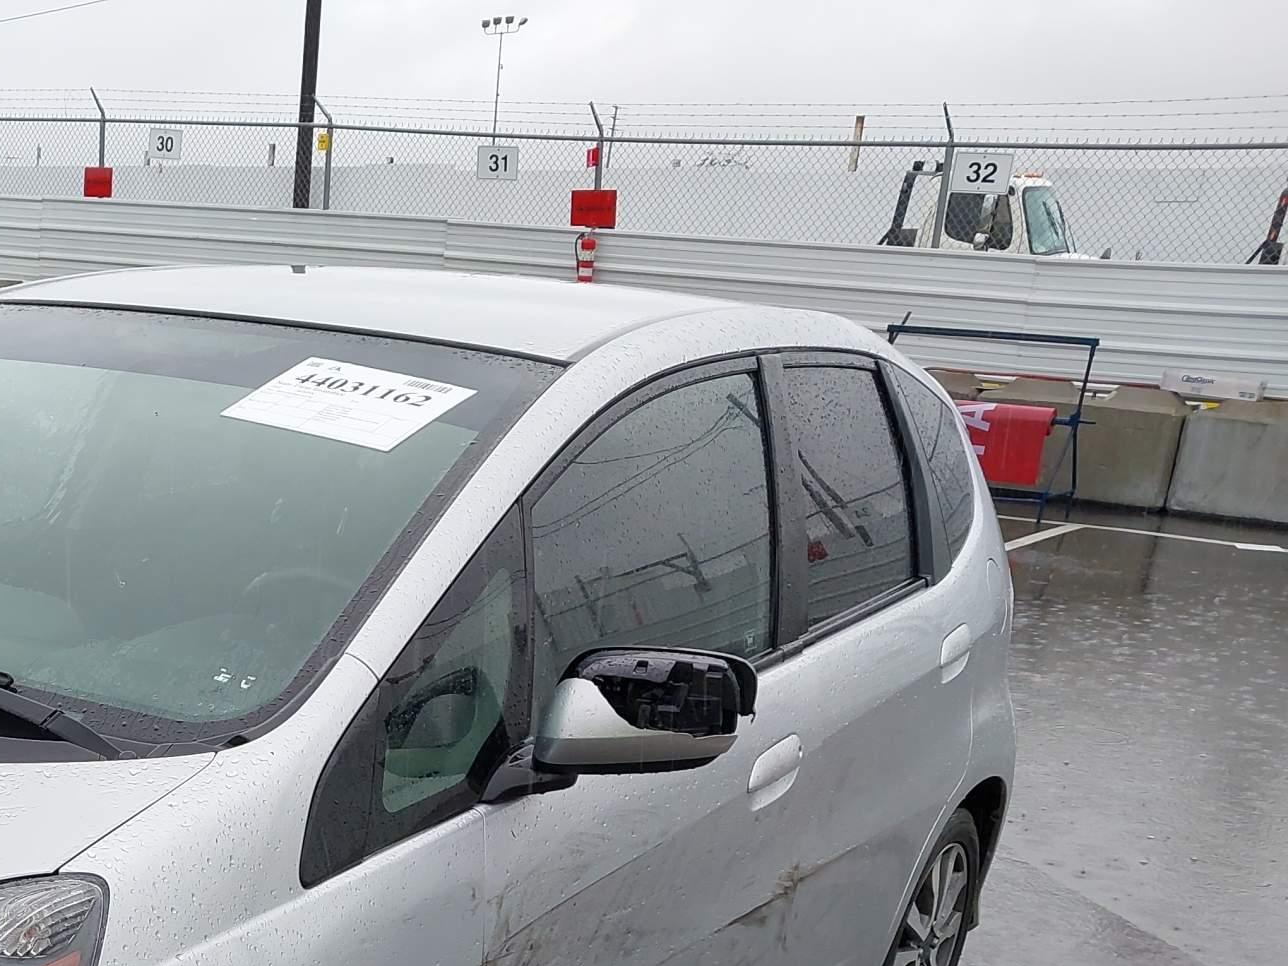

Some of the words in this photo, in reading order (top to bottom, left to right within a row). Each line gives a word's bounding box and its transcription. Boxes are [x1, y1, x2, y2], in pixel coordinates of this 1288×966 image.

[156, 135, 174, 152] 30
[488, 154, 508, 172] 31
[966, 162, 998, 183] 32
[295, 372, 433, 408] 44031162
